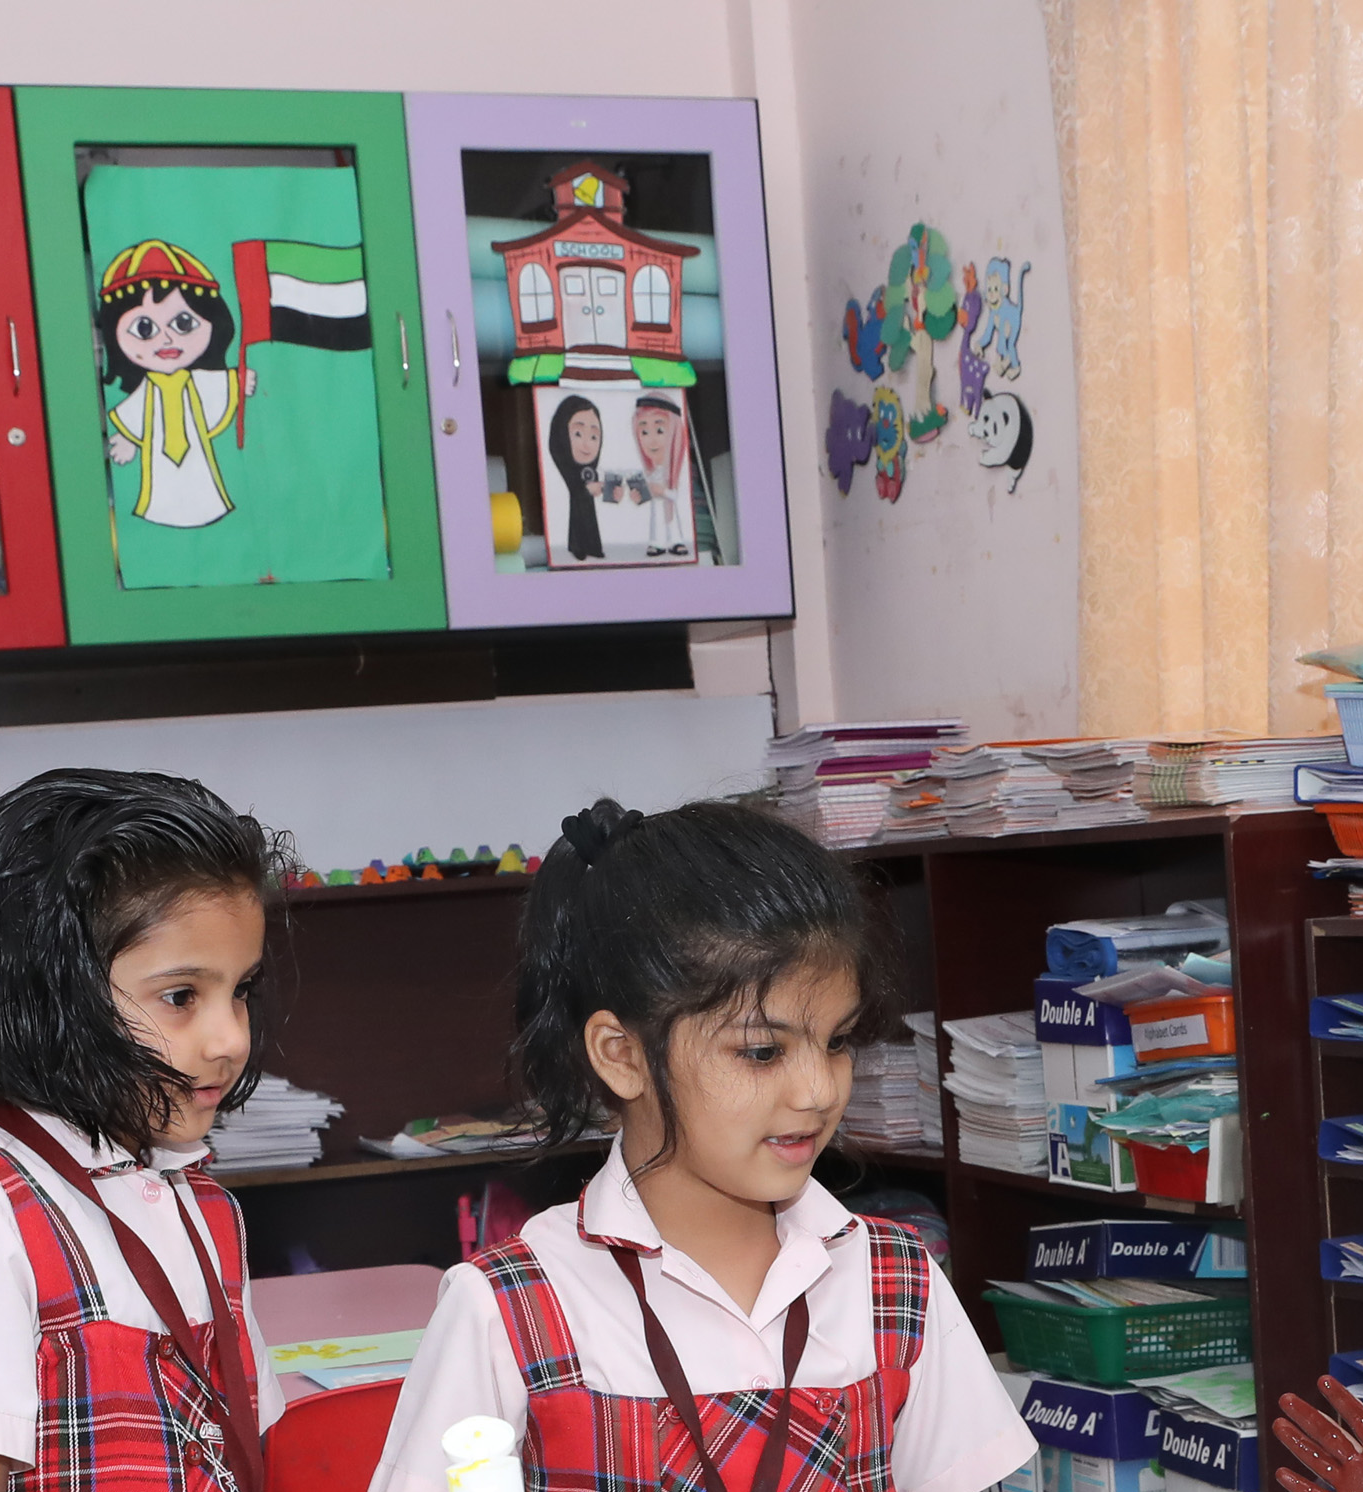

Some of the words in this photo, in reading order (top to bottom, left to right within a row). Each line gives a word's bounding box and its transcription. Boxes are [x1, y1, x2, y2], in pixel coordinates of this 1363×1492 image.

[560, 242, 622, 259] SCHOOL
[1040, 999, 1082, 1026] Double
[1084, 1001, 1096, 1027] A
[1169, 1021, 1189, 1038] Cards
[1035, 1240, 1074, 1268] Double
[1076, 1240, 1086, 1263] A
[1111, 1242, 1168, 1257] Double
[1172, 1242, 1187, 1257] A
[1025, 1400, 1077, 1431] Double
[1079, 1411, 1098, 1436] A
[1162, 1426, 1211, 1465] Double
[1213, 1443, 1227, 1470] A
